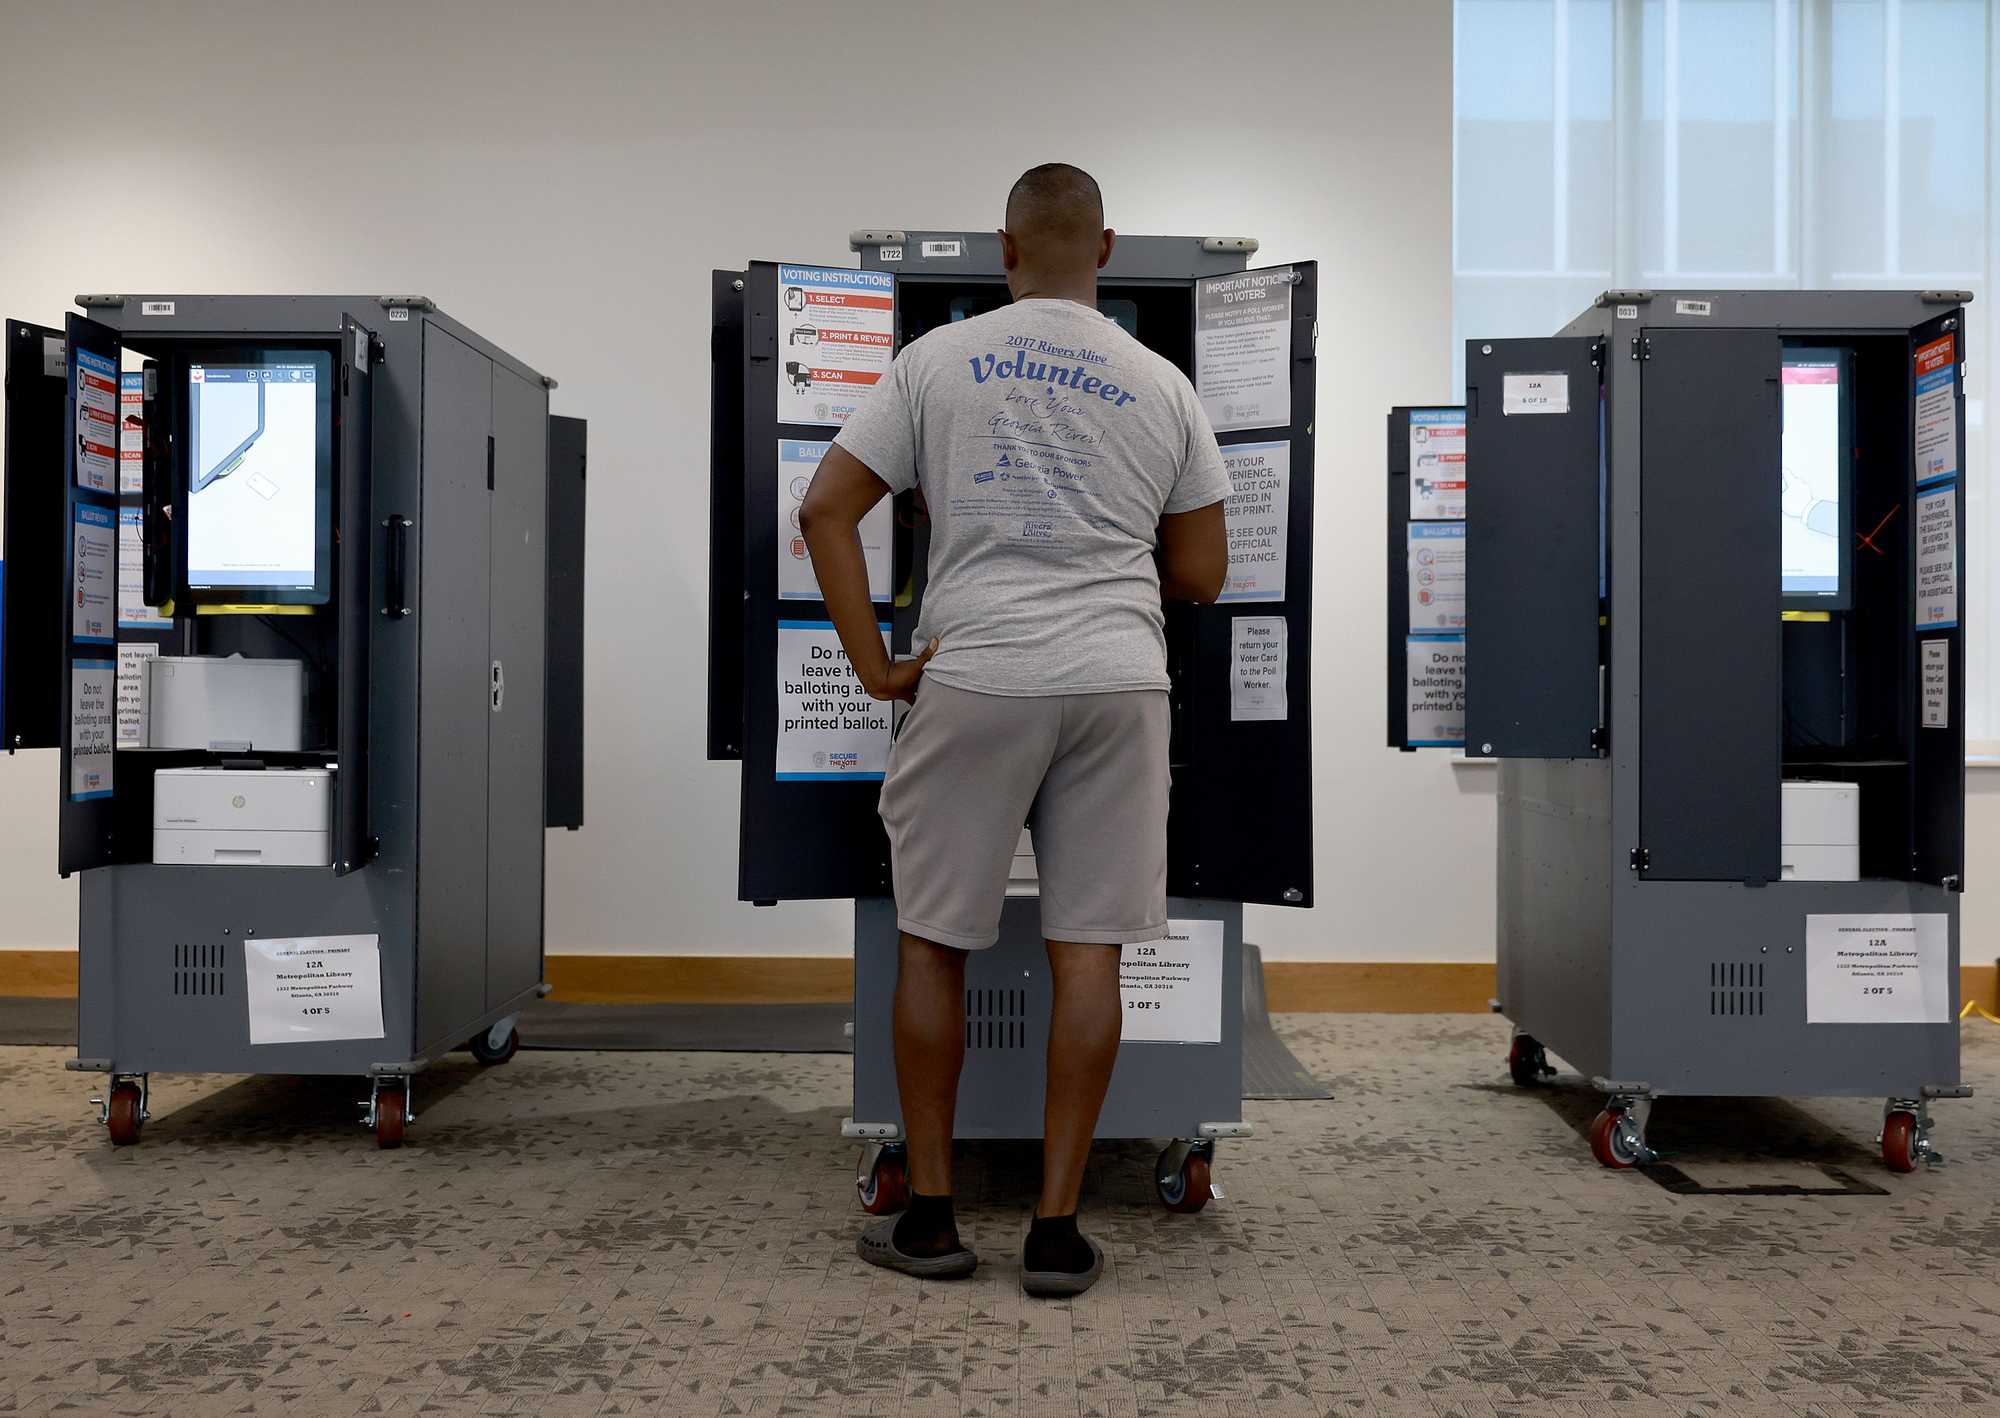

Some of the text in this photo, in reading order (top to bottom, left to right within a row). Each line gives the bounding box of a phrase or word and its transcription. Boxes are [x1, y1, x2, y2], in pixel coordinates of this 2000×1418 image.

[881, 250, 901, 259] 1722
[783, 269, 892, 288] VOTING INSTRUCTIONS
[1206, 274, 1282, 294] IMPORTANT NOTIC
[809, 294, 846, 304] 1. SELECT
[1223, 289, 1266, 304] TO VOTERS
[390, 309, 408, 319] 0220
[1247, 306, 1261, 315] POLL
[1618, 308, 1636, 317] 0031
[821, 331, 829, 339] 2.
[830, 332, 852, 341] PRINT
[860, 334, 889, 344] REVIEW
[1005, 335, 1108, 364] 2017 Rivers Alive
[813, 371, 843, 380] 3. SCAN
[968, 350, 1137, 407] Volunteer
[987, 410, 1044, 434] Georgia
[993, 443, 1017, 451] THANK
[1030, 449, 1039, 457] TO
[1039, 450, 1055, 459] OUR
[1237, 456, 1265, 467] YOUR
[1053, 466, 1085, 482] Power
[1259, 479, 1280, 489] CAN
[1225, 492, 1271, 505] VIEWED IN
[1243, 504, 1274, 515] PRINT.
[1236, 526, 1278, 538] SEE OUR
[1230, 537, 1272, 550] OFFICIAL
[1248, 627, 1271, 636] Please
[1239, 641, 1278, 650] return your
[811, 646, 832, 660] Do
[1240, 653, 1278, 663] Voter Card
[1432, 654, 1450, 663] Do
[801, 663, 842, 677] leave
[1240, 666, 1277, 676] to the Poll
[1425, 665, 1456, 675] leave
[1243, 681, 1271, 689] Worker.
[1412, 677, 1462, 689] balloting
[83, 683, 102, 695] Do not
[784, 681, 850, 697] balloting
[1424, 689, 1450, 699] with
[801, 698, 872, 715] with your
[1411, 702, 1452, 714] printed
[784, 716, 888, 732] printed ballot.
[1137, 948, 1156, 956] 12A
[306, 961, 323, 969] 12A
[1159, 961, 1190, 969] Library
[276, 971, 353, 980] Metropolitan Library
[1128, 1001, 1161, 1009] 3 OF 5
